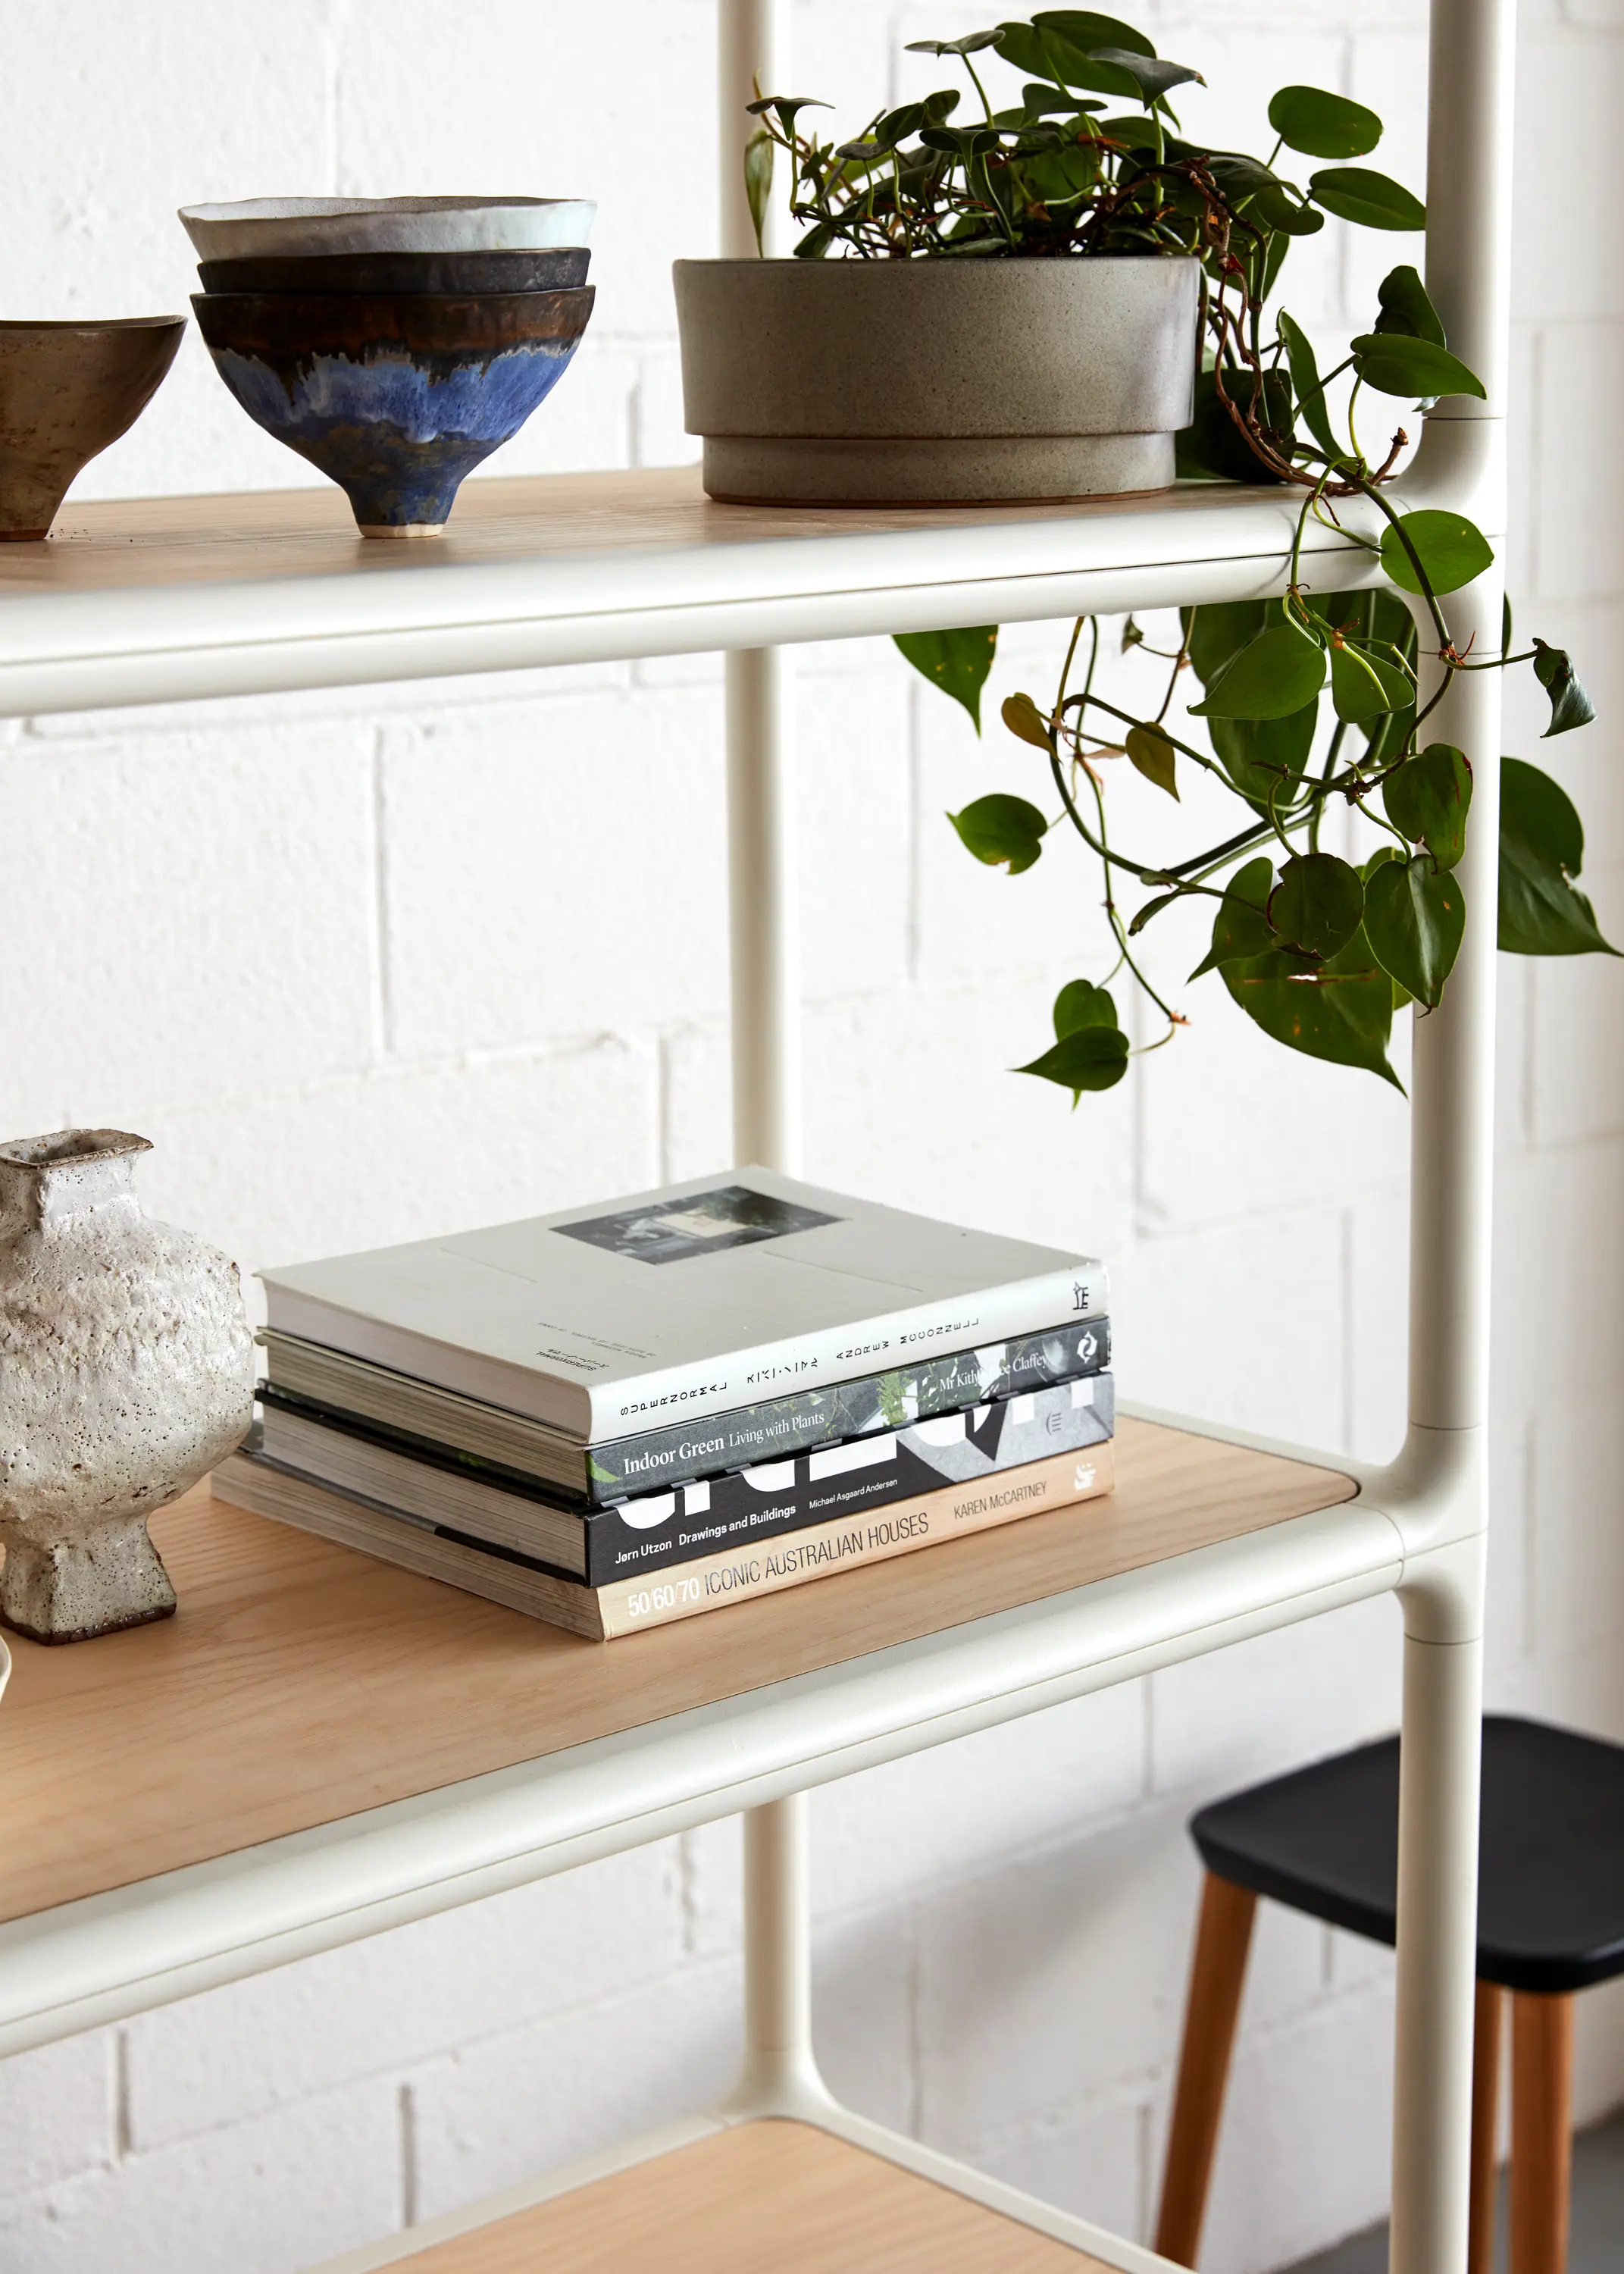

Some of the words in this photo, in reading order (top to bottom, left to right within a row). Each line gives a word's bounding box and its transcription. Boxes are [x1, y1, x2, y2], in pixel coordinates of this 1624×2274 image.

[836, 1341, 889, 1359] ANDREW
[900, 1317, 978, 1344] MCCONNELL
[940, 1377, 954, 1392] Mr
[1013, 1352, 1047, 1373] Claffey
[621, 1382, 727, 1416] SUPERNORMAL
[624, 1449, 676, 1474] Indoor
[679, 1437, 724, 1460] Green
[729, 1431, 764, 1447] Living
[765, 1422, 790, 1436] with
[792, 1412, 825, 1430] Plants
[615, 1550, 638, 1565] Jørn
[641, 1539, 671, 1557] Utzon
[679, 1525, 727, 1546] Drawings
[729, 1517, 747, 1532] and
[750, 1504, 796, 1526] Buildings
[809, 1495, 835, 1509] Michael
[837, 1487, 865, 1502] Asgaard
[865, 1479, 897, 1494] Andersen
[627, 1577, 699, 1618] 50/60/70
[705, 1561, 760, 1595] ICONIC
[765, 1530, 863, 1579] AUSTRALIAN
[868, 1512, 929, 1549] HOUSES
[953, 1496, 987, 1520] KAREN
[989, 1480, 1047, 1511] McCARTNEY
